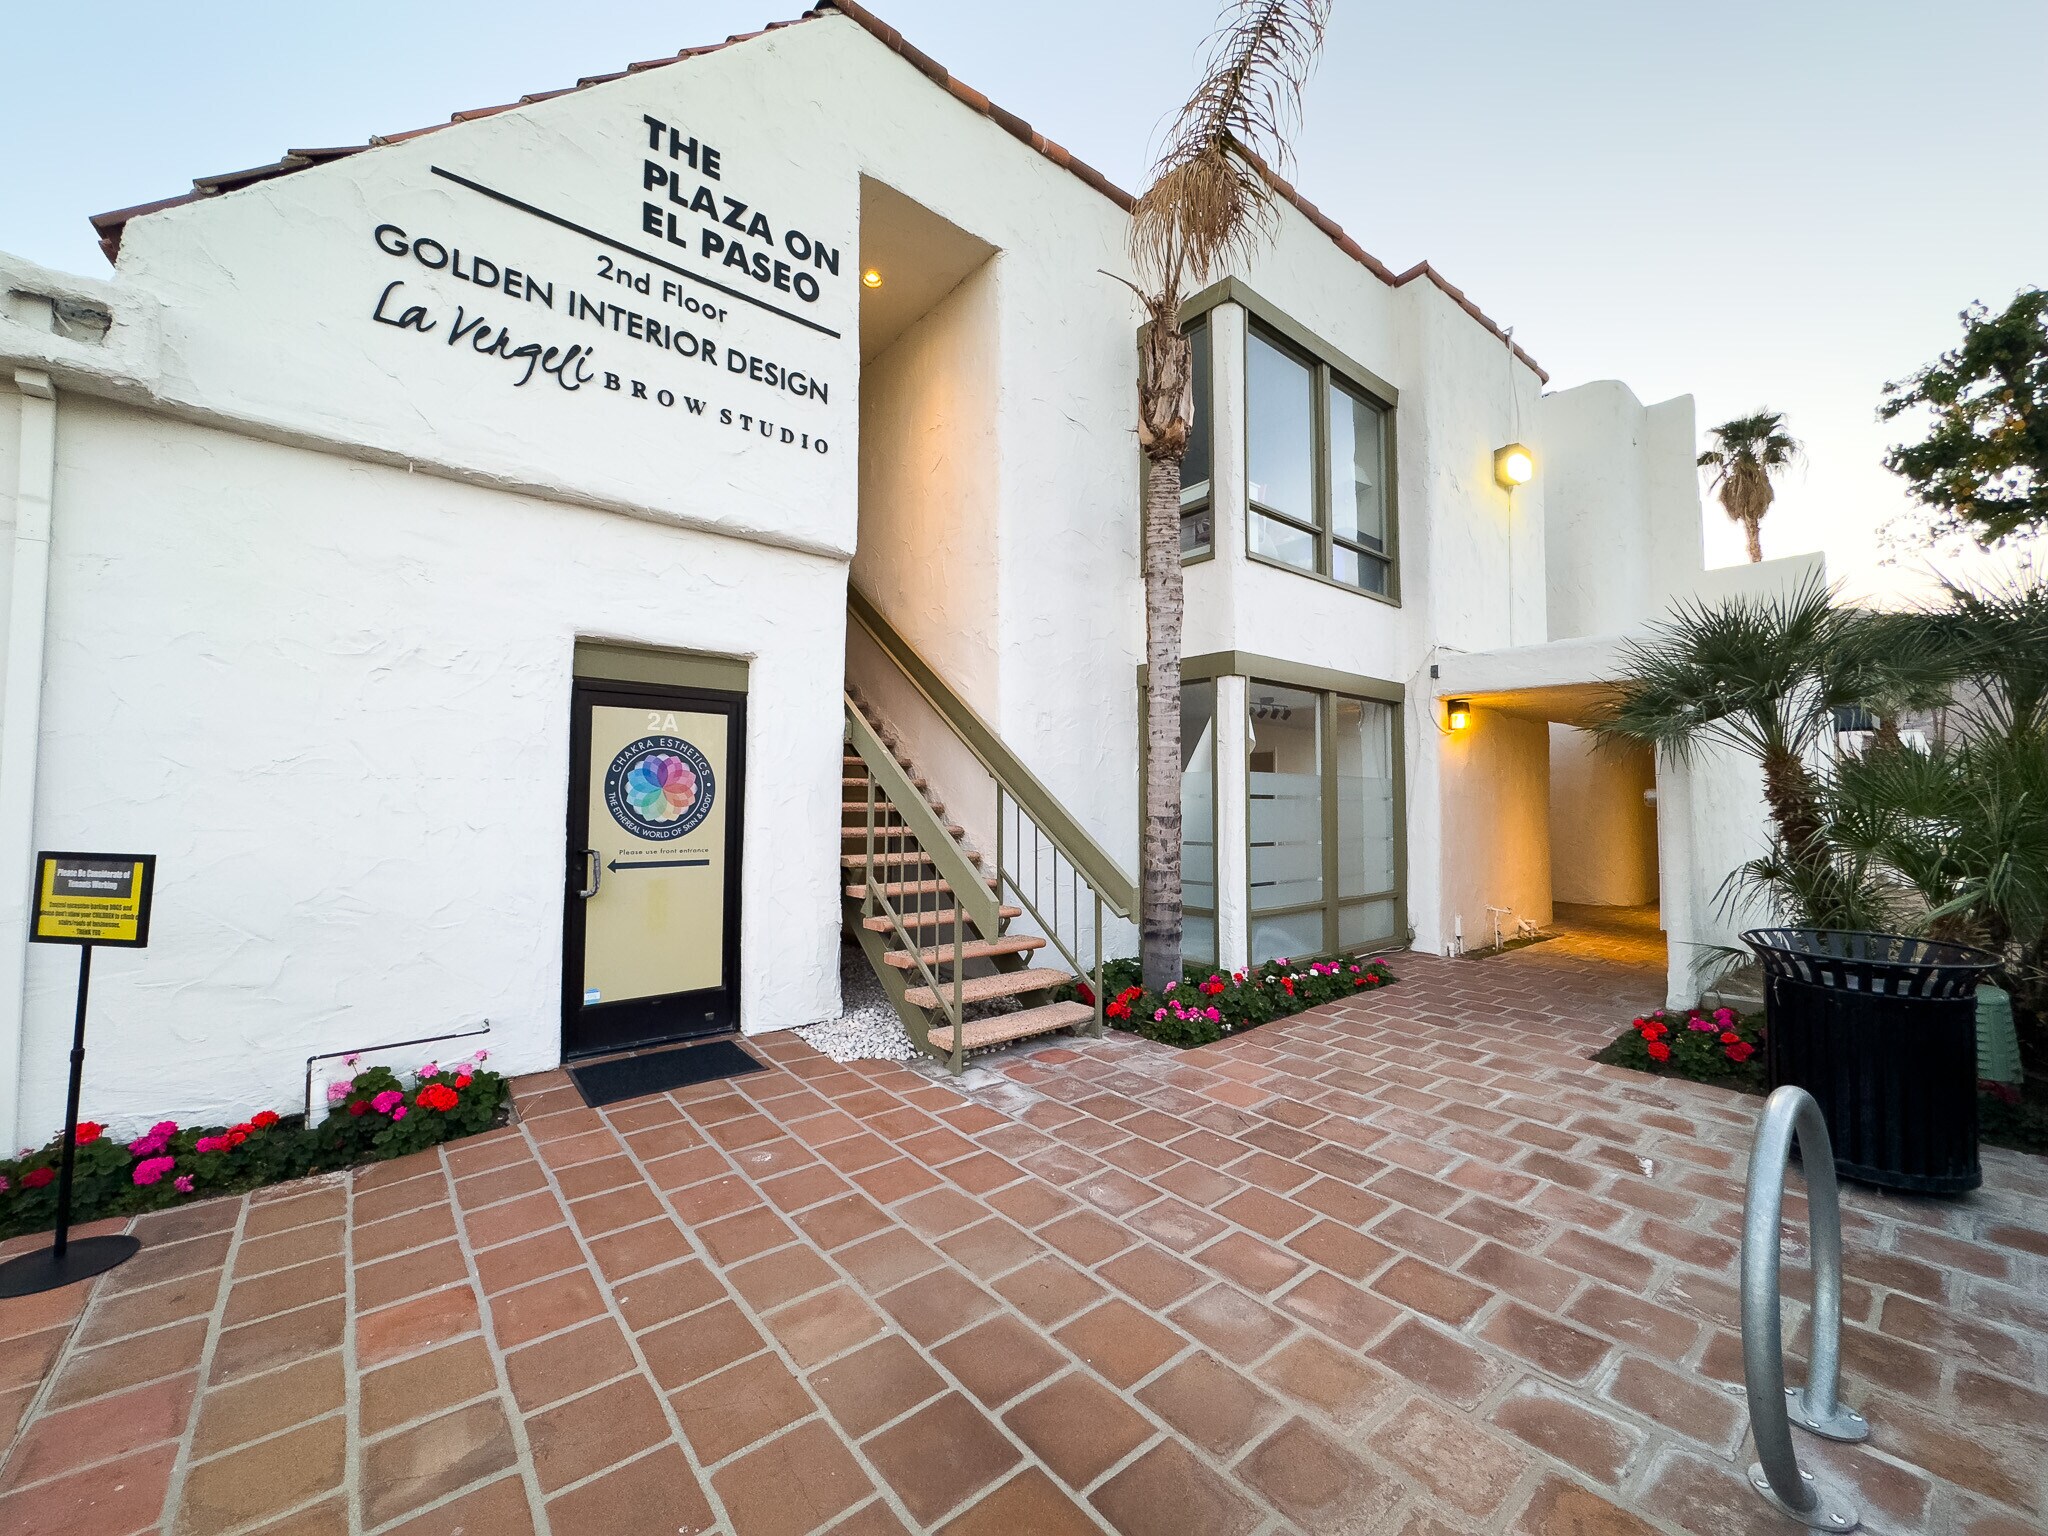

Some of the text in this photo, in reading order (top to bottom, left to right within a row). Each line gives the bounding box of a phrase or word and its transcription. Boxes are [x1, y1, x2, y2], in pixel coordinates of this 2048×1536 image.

[643, 114, 721, 180] THE
[643, 158, 839, 276] PLAZA ON
[642, 201, 820, 302] EL PASEO
[372, 281, 437, 333] La
[374, 223, 829, 405] GOLDEN INTERIOR DESIGN
[597, 254, 728, 323] 2nd Floor
[604, 371, 829, 455] BROW STUDIO
[647, 713, 679, 732] 2A
[612, 738, 710, 776] CHAKRA ESTHETICS
[608, 792, 618, 808] THE
[613, 807, 640, 834] ETHEREAL
[642, 829, 670, 839] WORLD
[671, 828, 682, 836] OF
[682, 817, 699, 832] SKIN
[700, 793, 712, 813] BODY
[57, 868, 77, 877] Please
[78, 869, 86, 877] Be
[87, 869, 122, 878] Considerate
